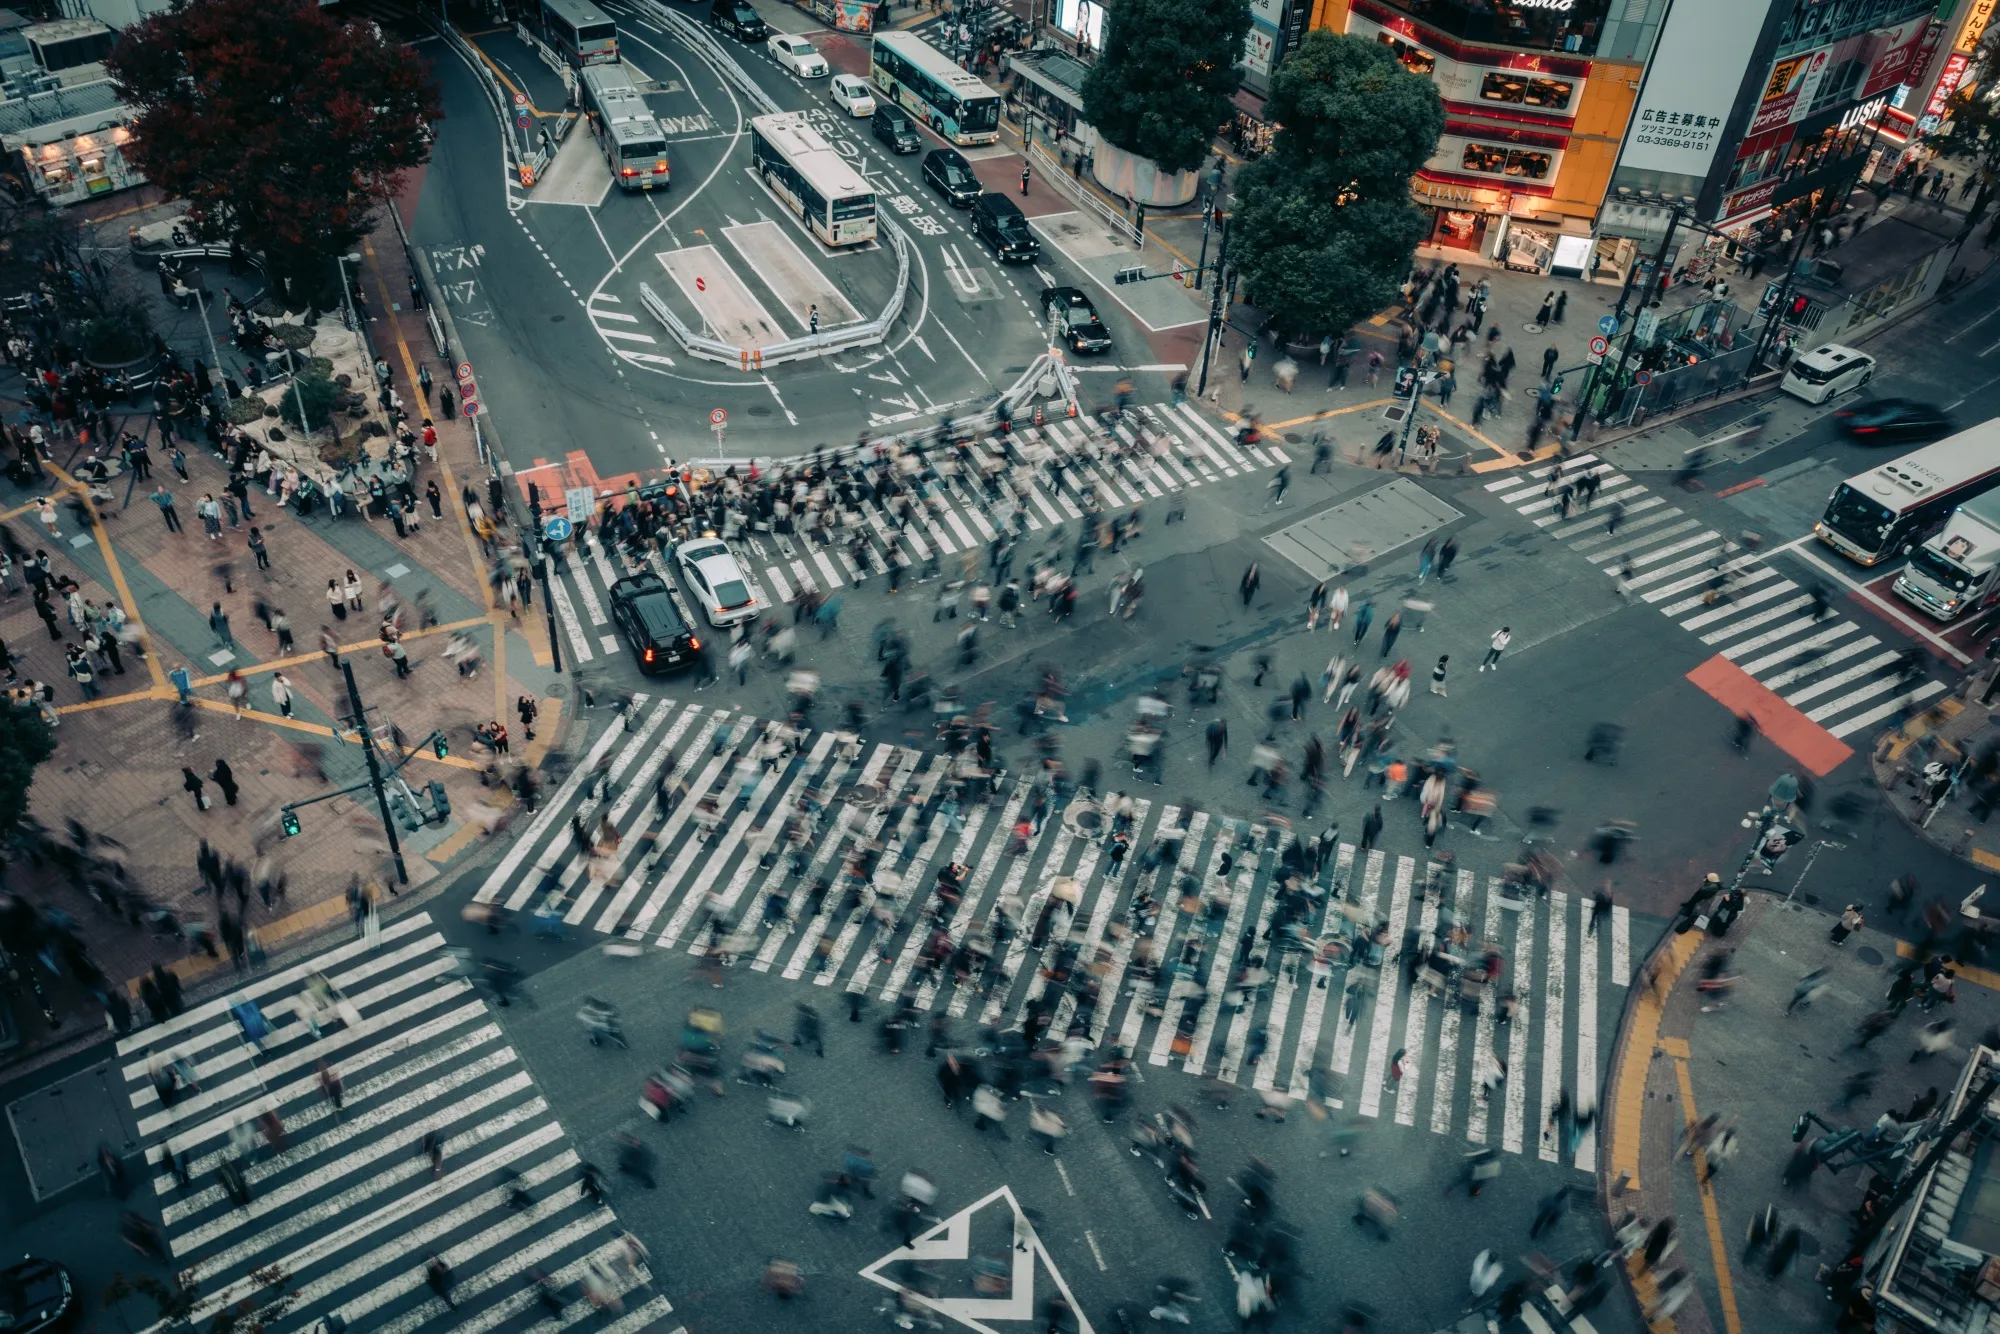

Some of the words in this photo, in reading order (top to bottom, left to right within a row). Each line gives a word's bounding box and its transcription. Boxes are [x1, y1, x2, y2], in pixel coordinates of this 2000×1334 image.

[1878, 47, 1909, 74] アコム
[1767, 65, 1793, 97] 薬
[1641, 108, 1720, 129] 広告主募集中
[1838, 96, 1886, 131] LUSH
[1636, 134, 1709, 151] 03-3369-8151
[1640, 124, 1713, 140] ツツミプロジェクト
